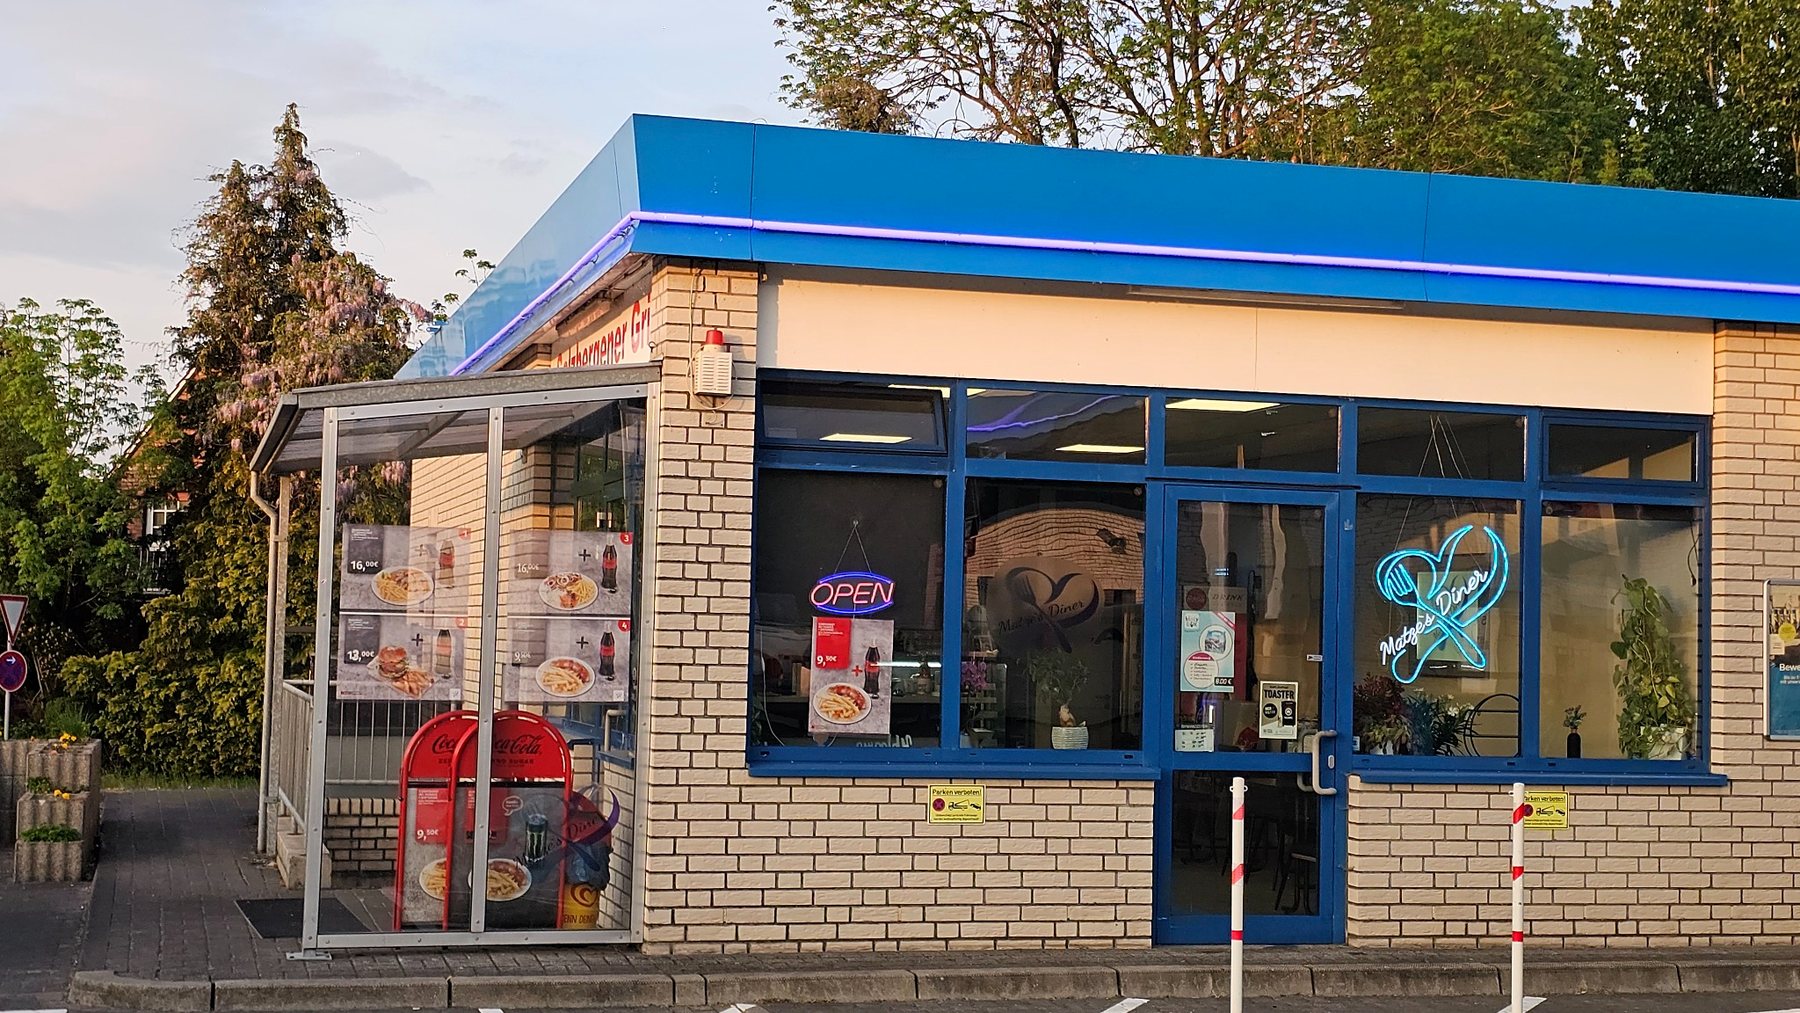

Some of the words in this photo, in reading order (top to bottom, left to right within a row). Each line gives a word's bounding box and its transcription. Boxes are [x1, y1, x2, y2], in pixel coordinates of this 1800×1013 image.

[632, 292, 651, 353] Gri
[623, 534, 630, 543] 3
[350, 560, 379, 572] 16,00€
[810, 582, 894, 606] OPEN
[1435, 570, 1489, 616] Diner
[1048, 600, 1085, 617] Diner
[620, 621, 628, 629] 4
[816, 655, 837, 667] 9,50€
[1263, 689, 1295, 699] TOASTER
[432, 734, 456, 755] Coc
[954, 789, 982, 797] verboten!
[416, 829, 439, 841] 9,50€
